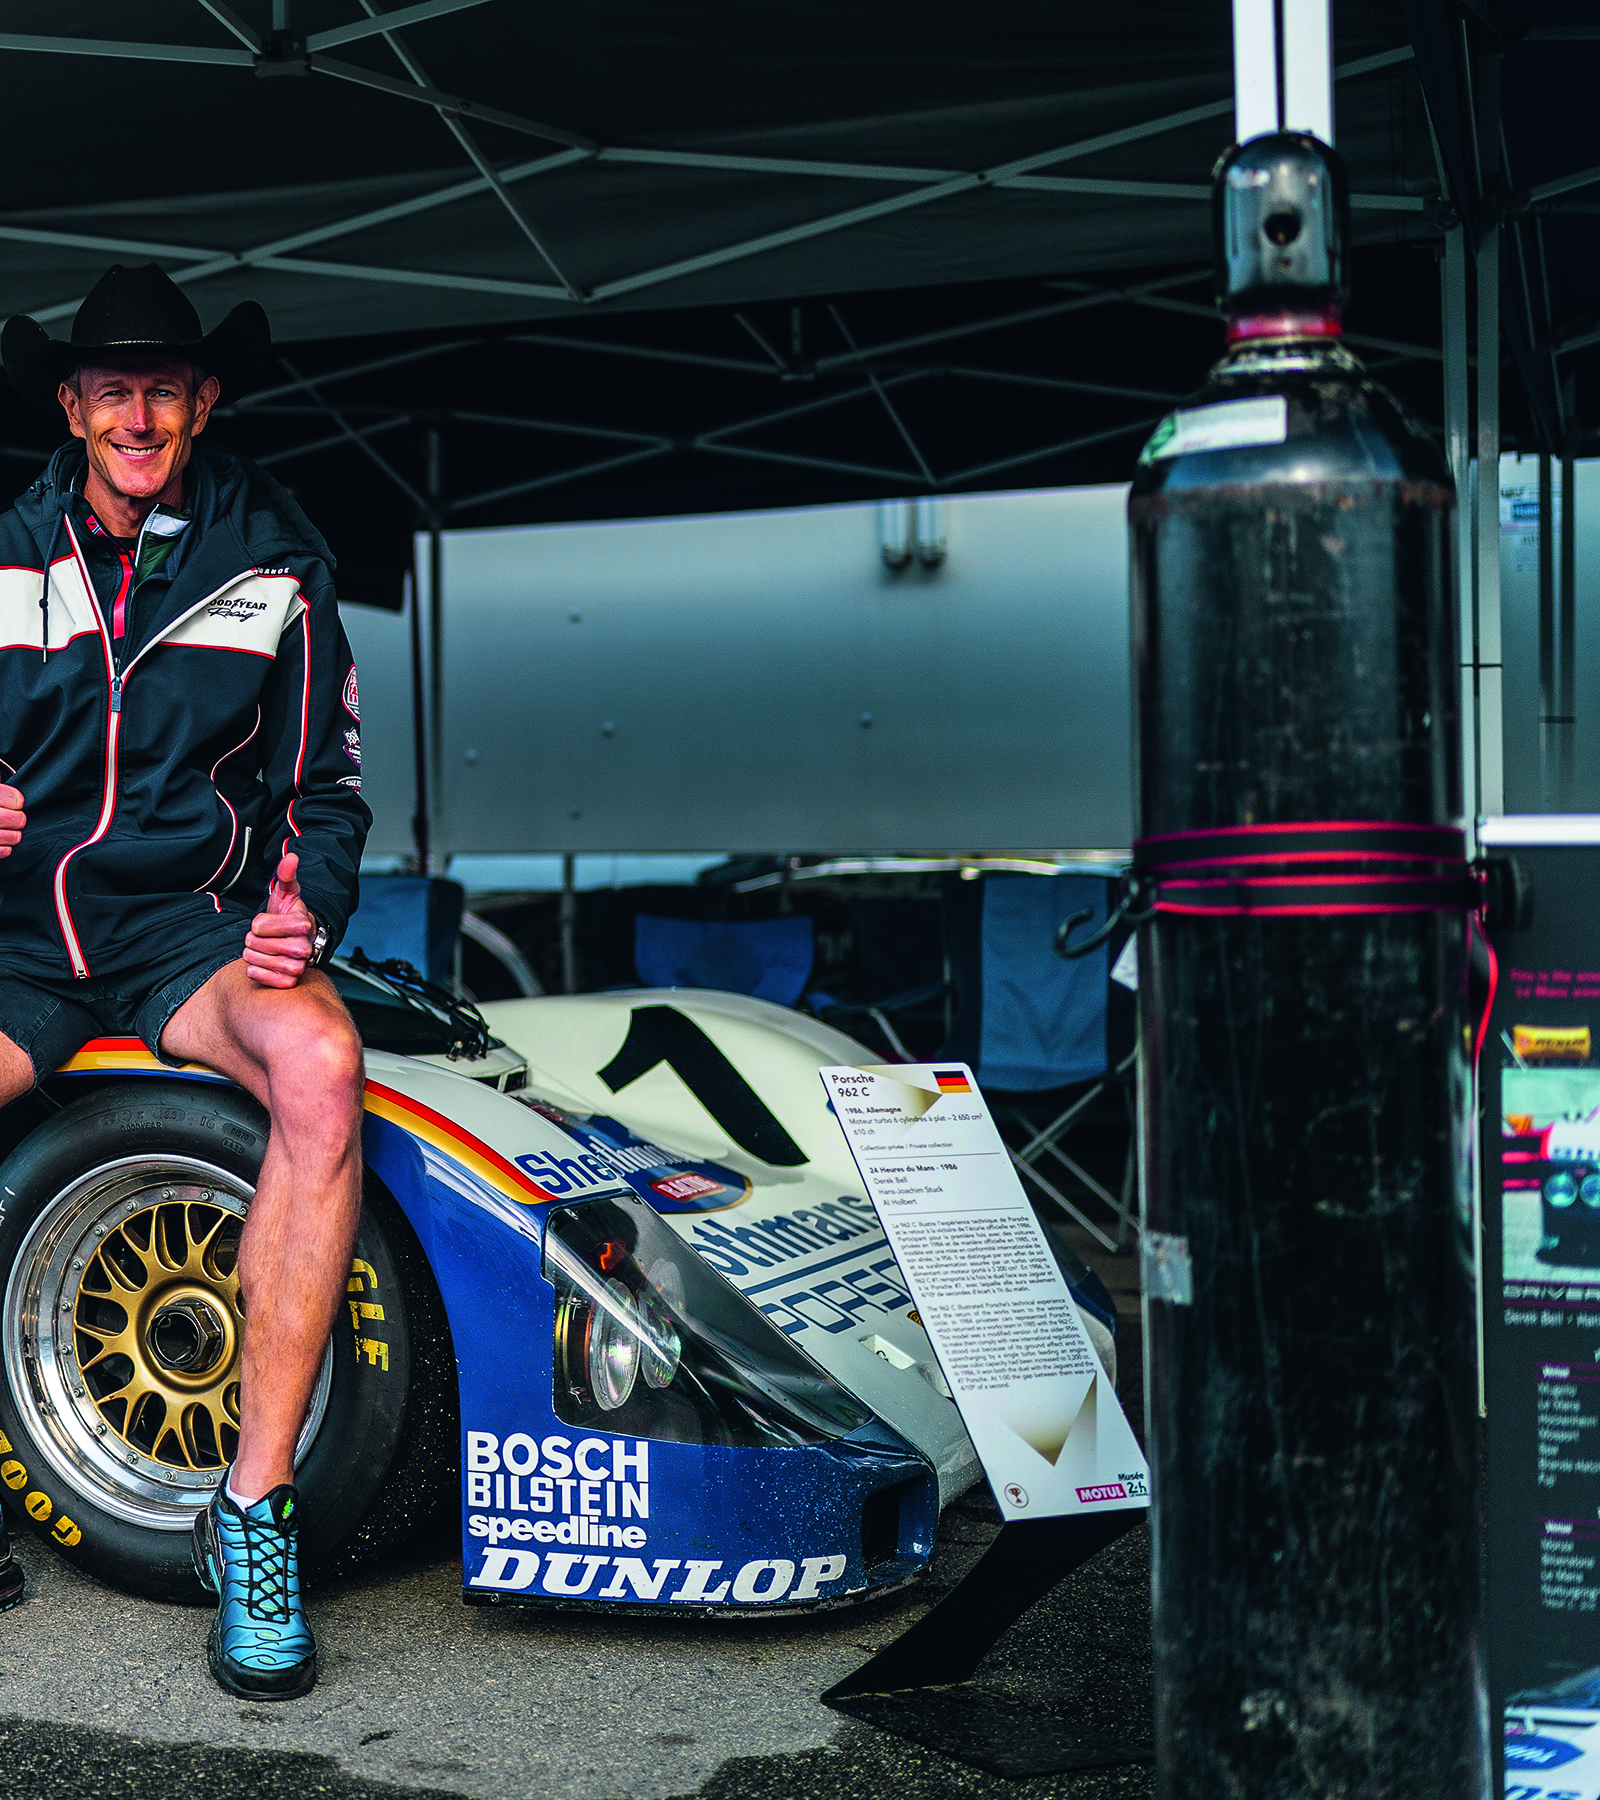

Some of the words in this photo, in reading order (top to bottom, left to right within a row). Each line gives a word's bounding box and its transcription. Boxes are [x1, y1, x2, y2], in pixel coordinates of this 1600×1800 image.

[209, 598, 268, 610] OODYEAR
[597, 1004, 810, 1167] 1
[831, 1073, 875, 1084] Porsche
[836, 1087, 859, 1097] 962
[860, 1086, 870, 1096] C
[865, 1106, 902, 1114] Allemagne
[898, 1115, 927, 1124] cylindres
[514, 1149, 616, 1194] She
[877, 1187, 924, 1195] Hans-Joachim
[690, 1196, 880, 1276] othmans
[347, 1258, 389, 1372] GLE
[467, 1430, 650, 1483] BOSCH
[1118, 1471, 1144, 1482] Musée
[467, 1472, 650, 1519] BILSTEIN
[1080, 1486, 1124, 1502] MOTUL
[468, 1515, 648, 1548] speedline
[469, 1546, 847, 1602] DUNLOP
